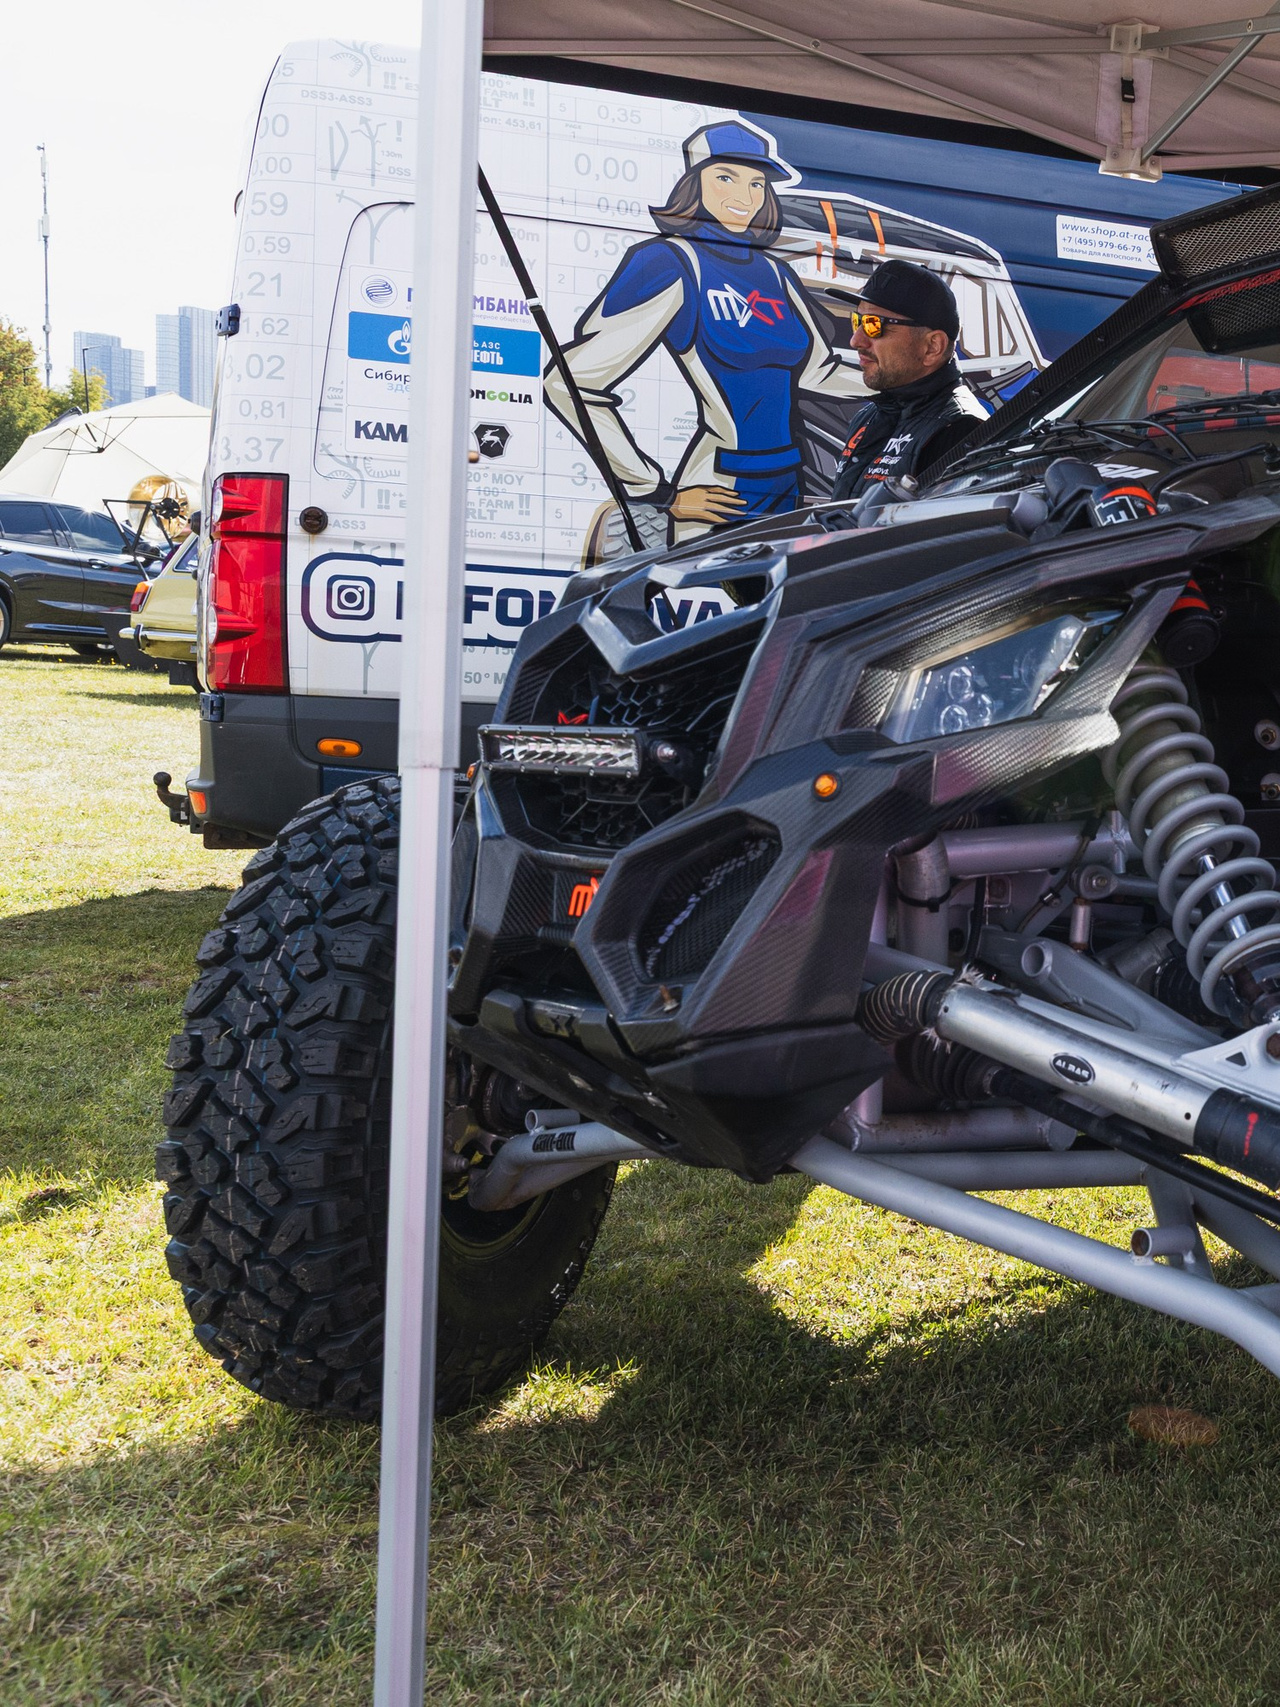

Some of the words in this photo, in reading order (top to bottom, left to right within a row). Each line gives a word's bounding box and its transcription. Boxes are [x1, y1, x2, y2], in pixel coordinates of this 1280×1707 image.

[300, 89, 373, 106] DSS3-ASS3
[484, 88, 519, 100] FARM
[597, 104, 642, 124] 0,35
[574, 152, 639, 182] 0,00
[597, 196, 641, 217] 0,00
[244, 235, 291, 254] 0,59
[1074, 237, 1097, 248] (495)
[1098, 240, 1142, 253] 979-66-79
[1063, 247, 1088, 255] ТОВАРЫ
[1102, 252, 1142, 262] АВТОСПОРТА
[473, 294, 530, 316] МБАНК
[481, 341, 500, 350] АЗС
[472, 350, 504, 365] ЕФТЬ
[364, 367, 411, 386] Сибир
[387, 383, 411, 394] зде
[238, 399, 285, 420] 0,81
[220, 436, 285, 465] 3,37
[491, 473, 524, 486] MOY
[479, 498, 514, 509] FARM
[500, 530, 537, 543] 453,61
